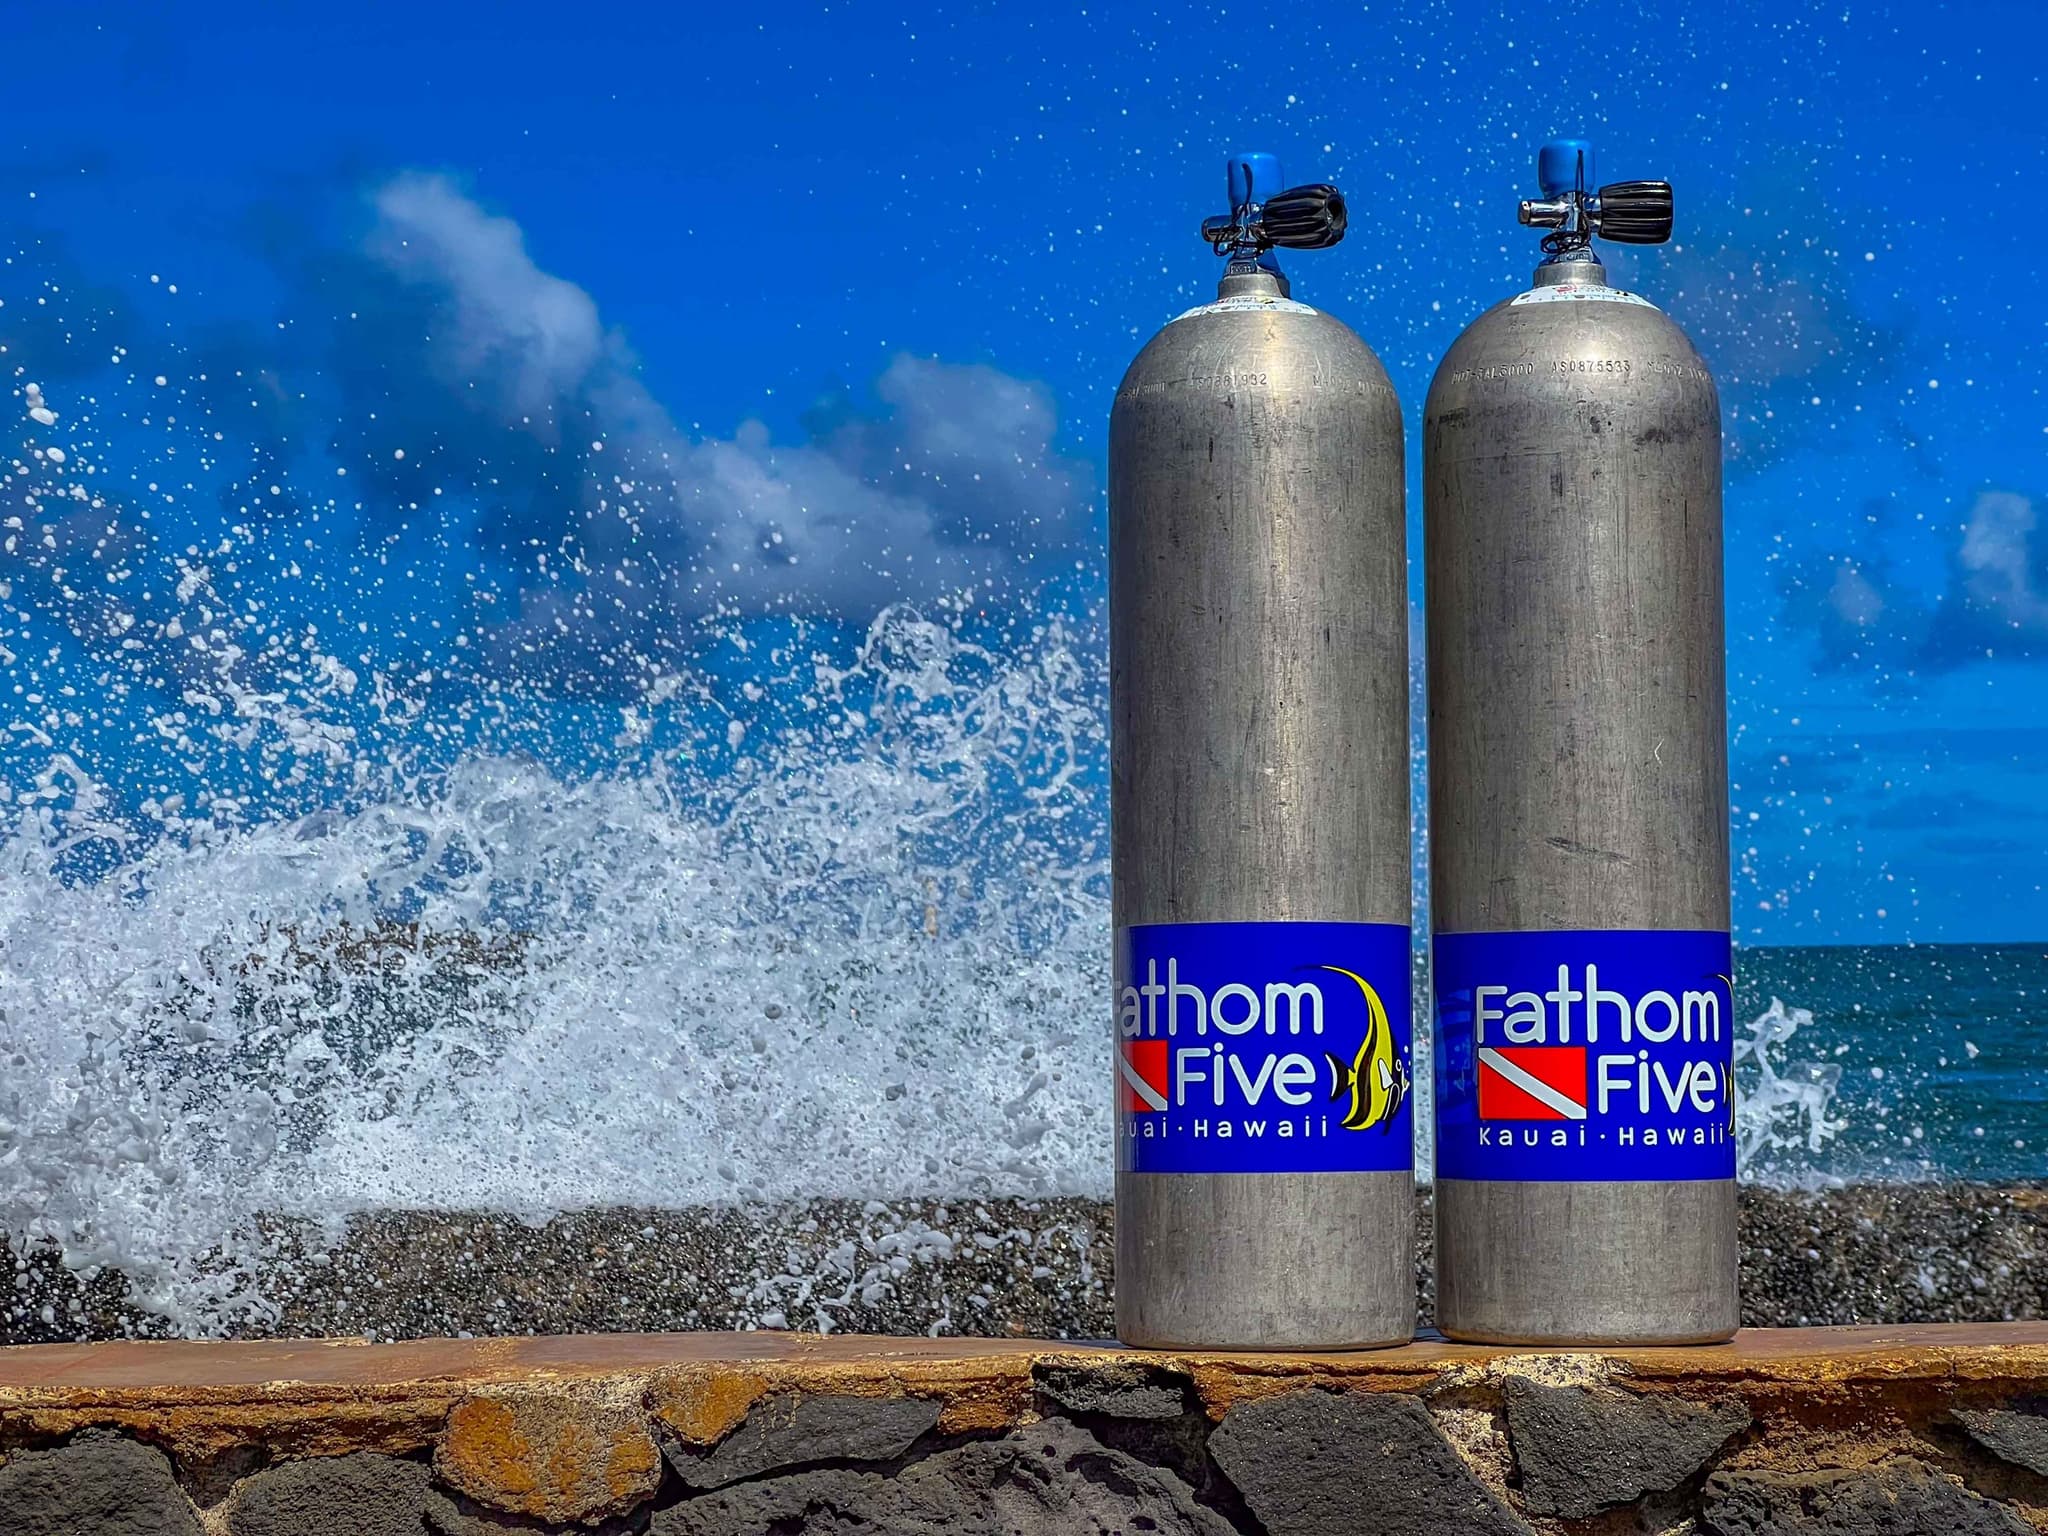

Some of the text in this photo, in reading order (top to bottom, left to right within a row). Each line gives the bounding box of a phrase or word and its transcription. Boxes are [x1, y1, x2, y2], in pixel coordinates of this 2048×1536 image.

[1115, 957, 1324, 1036] athom
[1476, 963, 1720, 1044] Fathom
[1176, 1042, 1316, 1106] Five
[1597, 1049, 1717, 1114] Five
[1194, 1115, 1328, 1138] Hawaii
[1479, 1122, 1724, 1147] Kauai Hawaii
